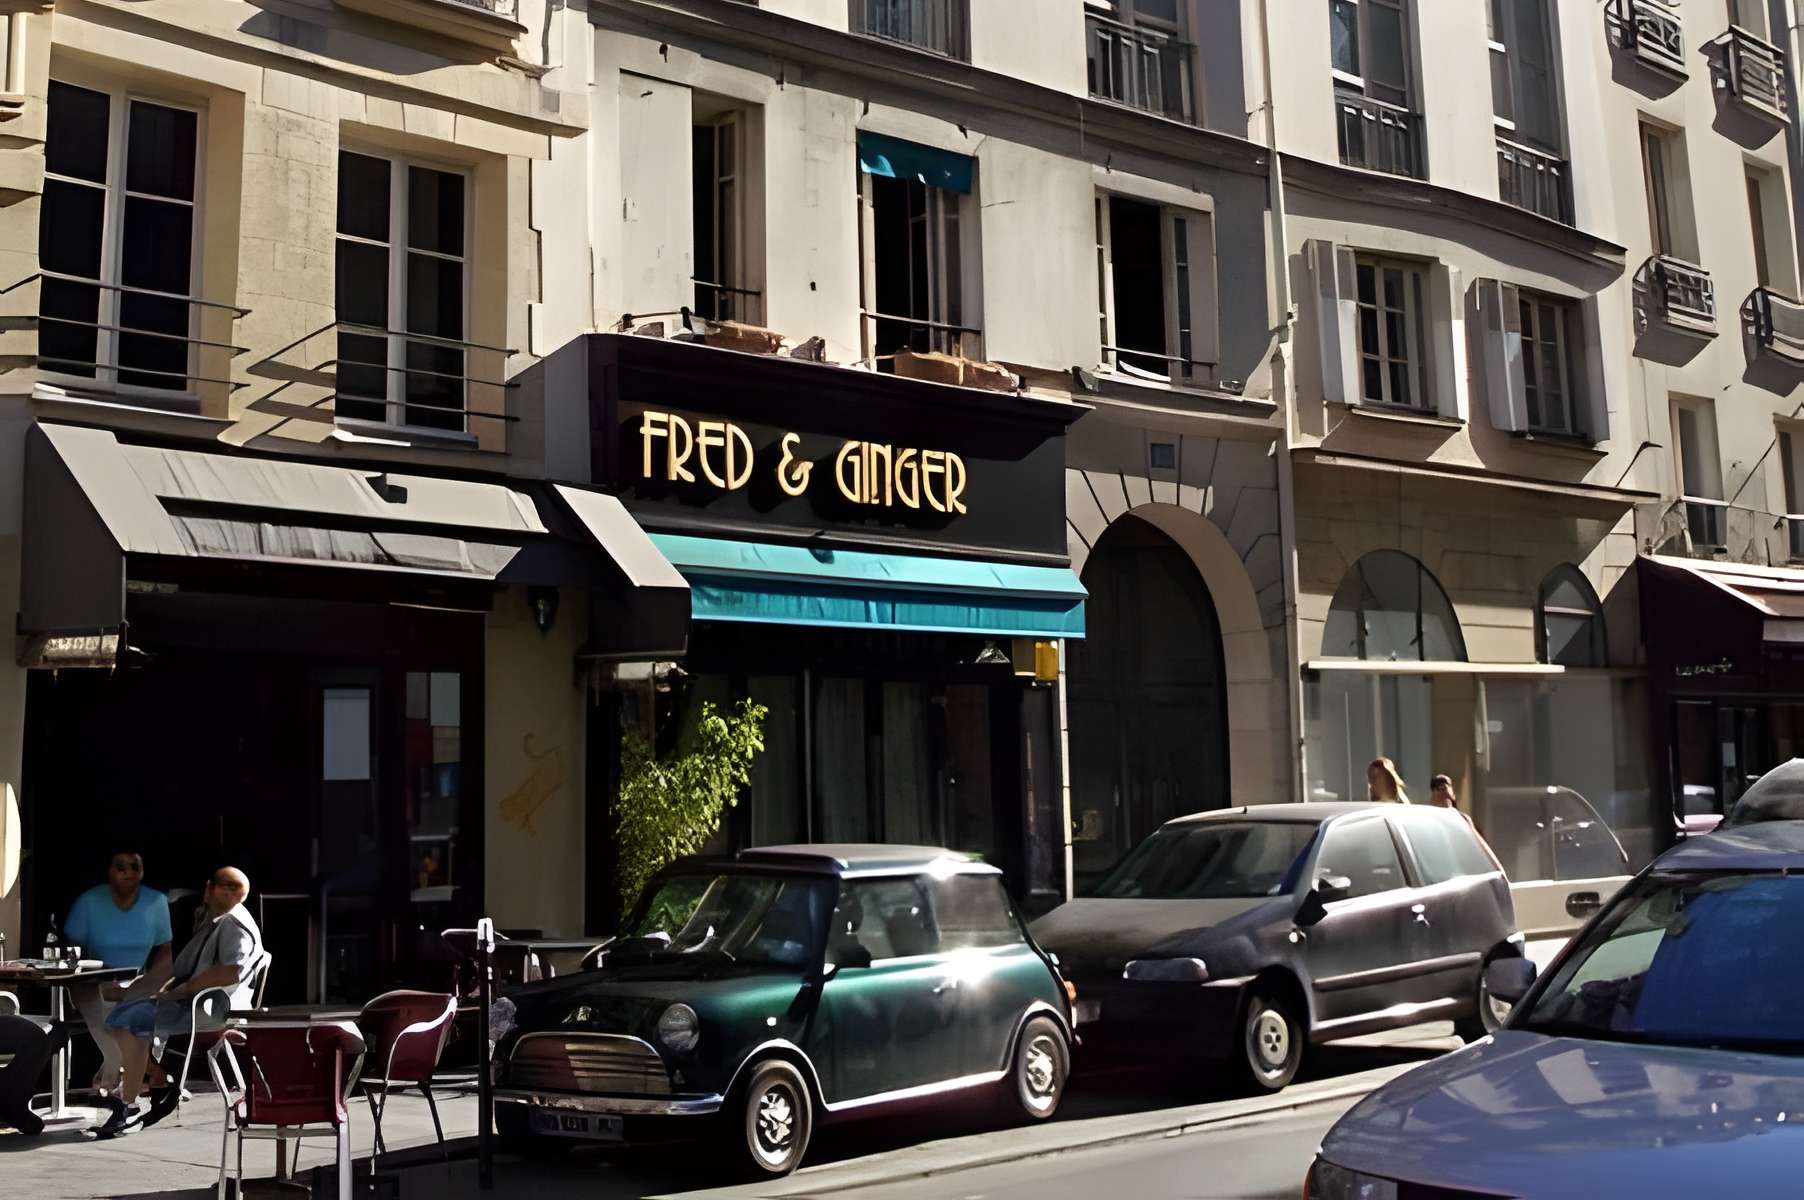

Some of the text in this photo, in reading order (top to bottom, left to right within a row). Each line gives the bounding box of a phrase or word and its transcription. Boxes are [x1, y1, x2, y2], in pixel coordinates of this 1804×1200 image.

[639, 410, 967, 515] FRED & GINGER
